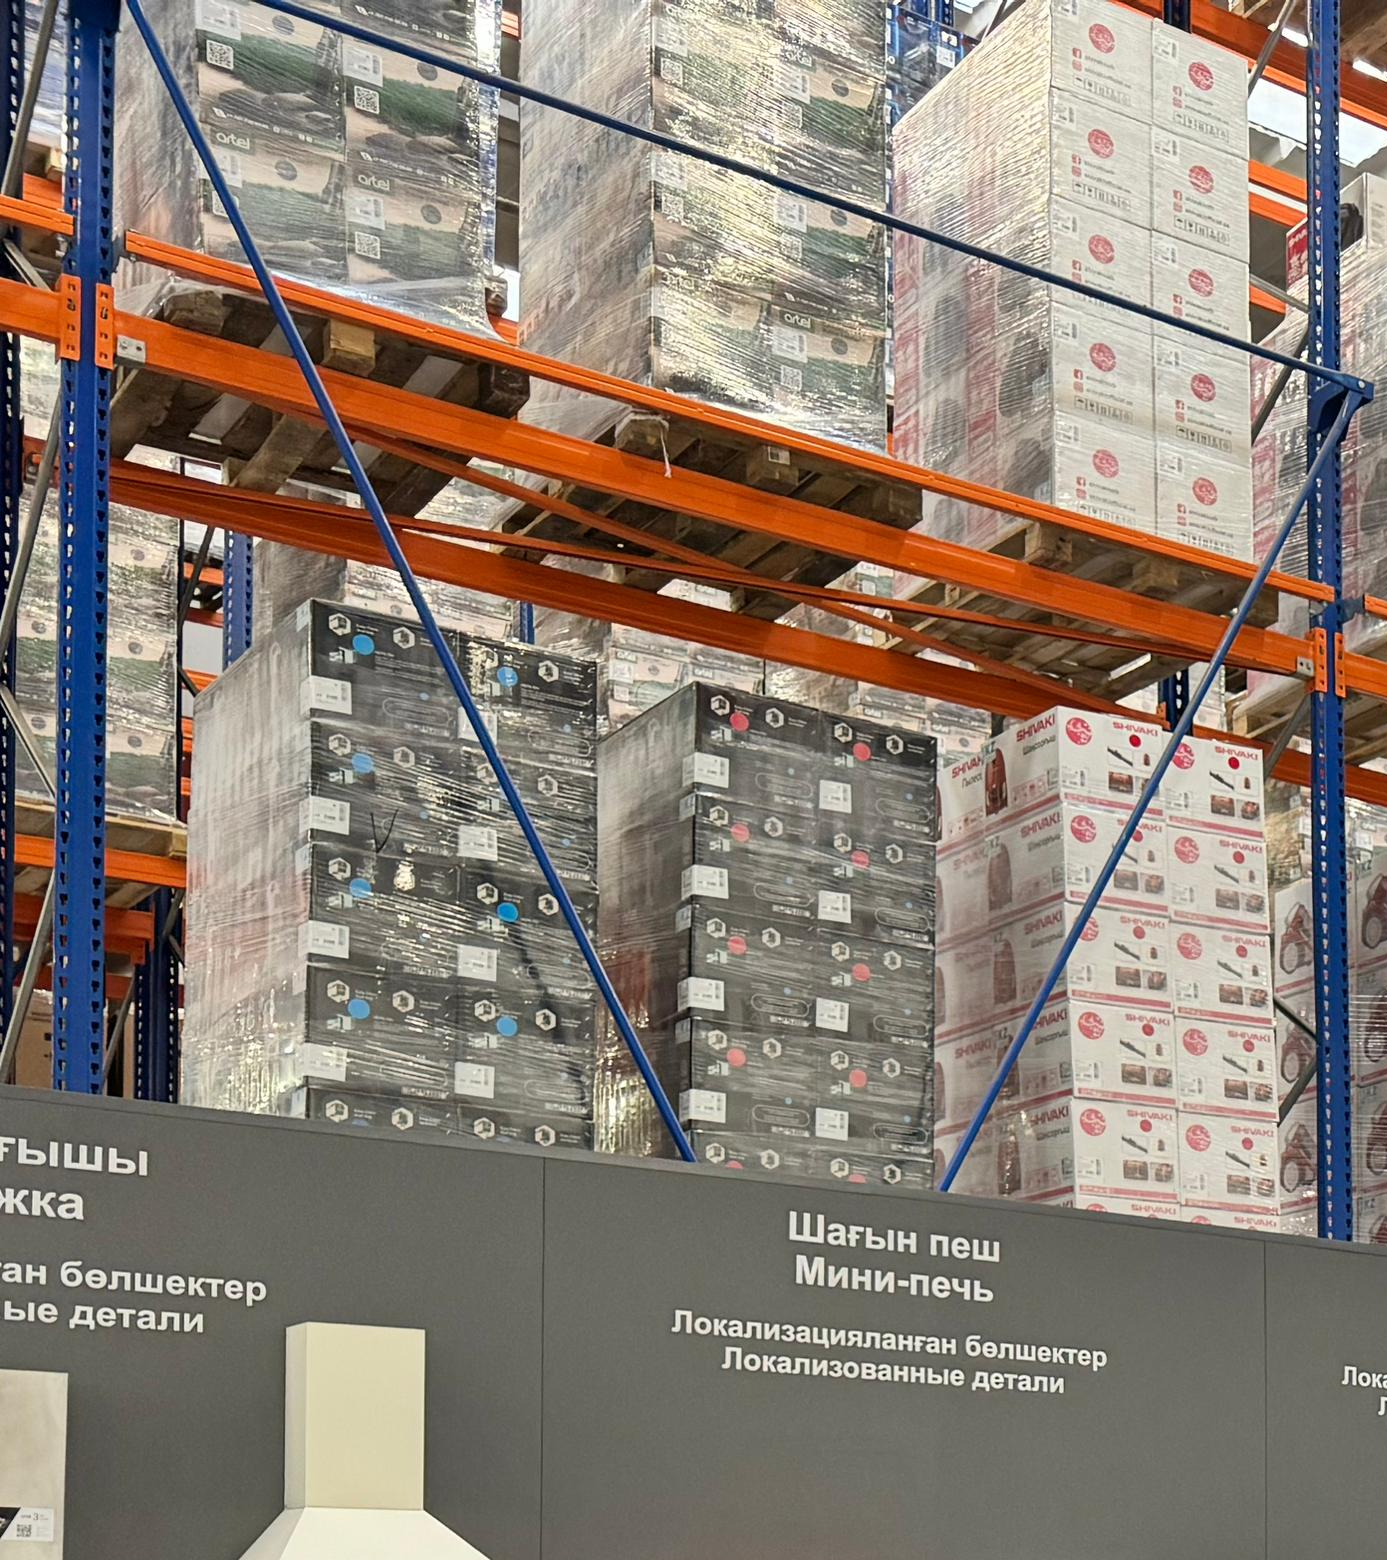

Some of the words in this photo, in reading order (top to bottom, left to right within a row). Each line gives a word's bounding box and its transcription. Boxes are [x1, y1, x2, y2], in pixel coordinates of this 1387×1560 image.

[216, 132, 250, 150] artel
[357, 173, 390, 191] artel
[784, 313, 810, 328] artel
[1016, 714, 1056, 743] SHIVAKI
[1112, 721, 1158, 737] SHIVAKI
[1214, 746, 1259, 761] SHIVAKI
[1020, 812, 1062, 838] SHIVAKI
[1117, 819, 1162, 833] SHVAKI
[1219, 839, 1263, 854] SHIVAKI
[1023, 910, 1063, 935] SHIVAKI
[1119, 915, 1166, 929] SHIVAKI
[1221, 934, 1266, 947] SHIVAKI
[1031, 1009, 1069, 1030] HIVAKI
[1125, 1013, 1170, 1027] SHIVAKI
[1227, 1030, 1271, 1043] SHIVAKI
[1029, 1106, 1069, 1126] SHIVAKI
[1126, 1110, 1173, 1122] SHIVAKI
[1231, 1125, 1275, 1138] SHIVAKI
[1131, 1204, 1177, 1216] SHIVAKI
[1234, 1217, 1277, 1229] SHIVAKI
[788, 1210, 917, 1254] Шағын
[929, 1232, 1001, 1263] пеш
[60, 1260, 267, 1306] бөлшектер
[795, 1255, 994, 1302] Мини-печь
[69, 1305, 204, 1333] детали
[671, 1310, 957, 1356] Локализацияланған
[964, 1334, 1108, 1372] бөлшектер
[722, 1346, 965, 1387] Локализованные
[971, 1368, 1065, 1394] детали
